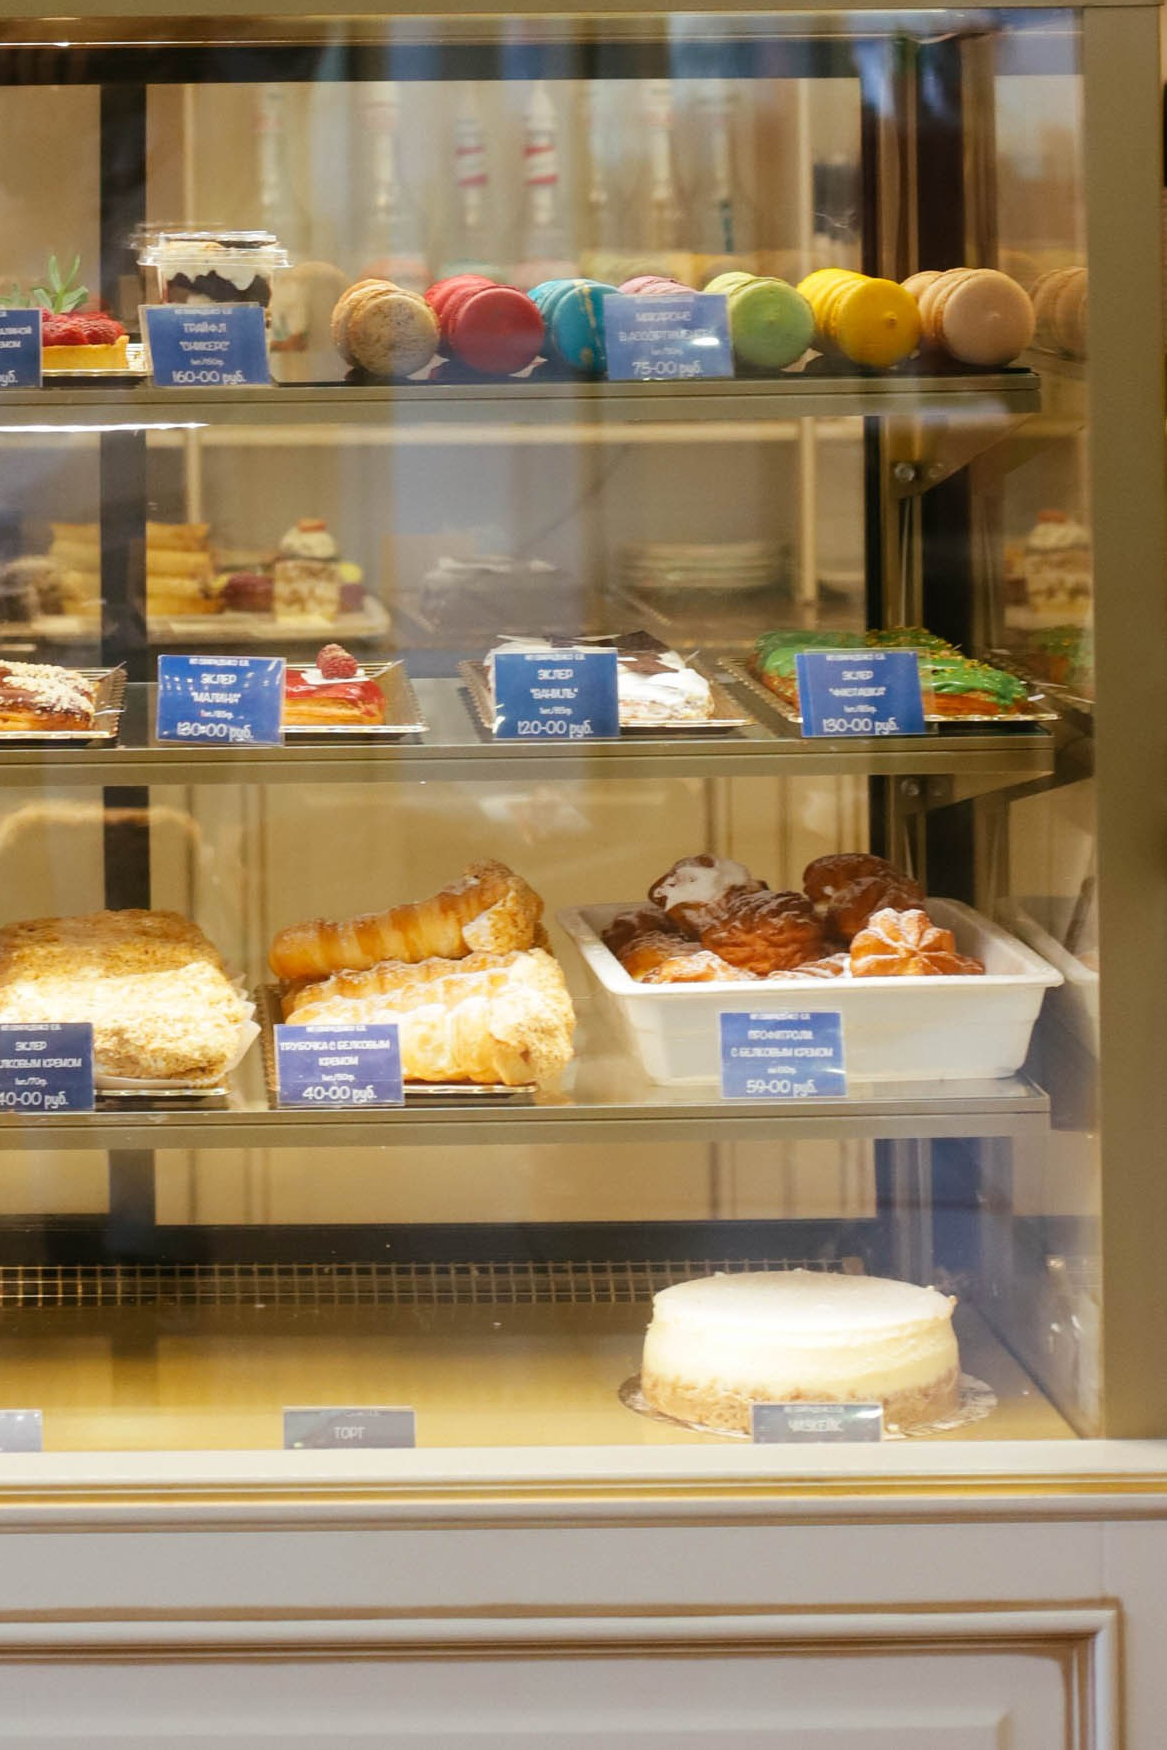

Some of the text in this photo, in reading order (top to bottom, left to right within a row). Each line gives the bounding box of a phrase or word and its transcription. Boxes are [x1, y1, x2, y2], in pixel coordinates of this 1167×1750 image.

[632, 361, 676, 375] 75-00
[517, 720, 567, 734] 120-00
[302, 1086, 351, 1100] 40-00
[334, 1426, 366, 1440] ТОРТ
